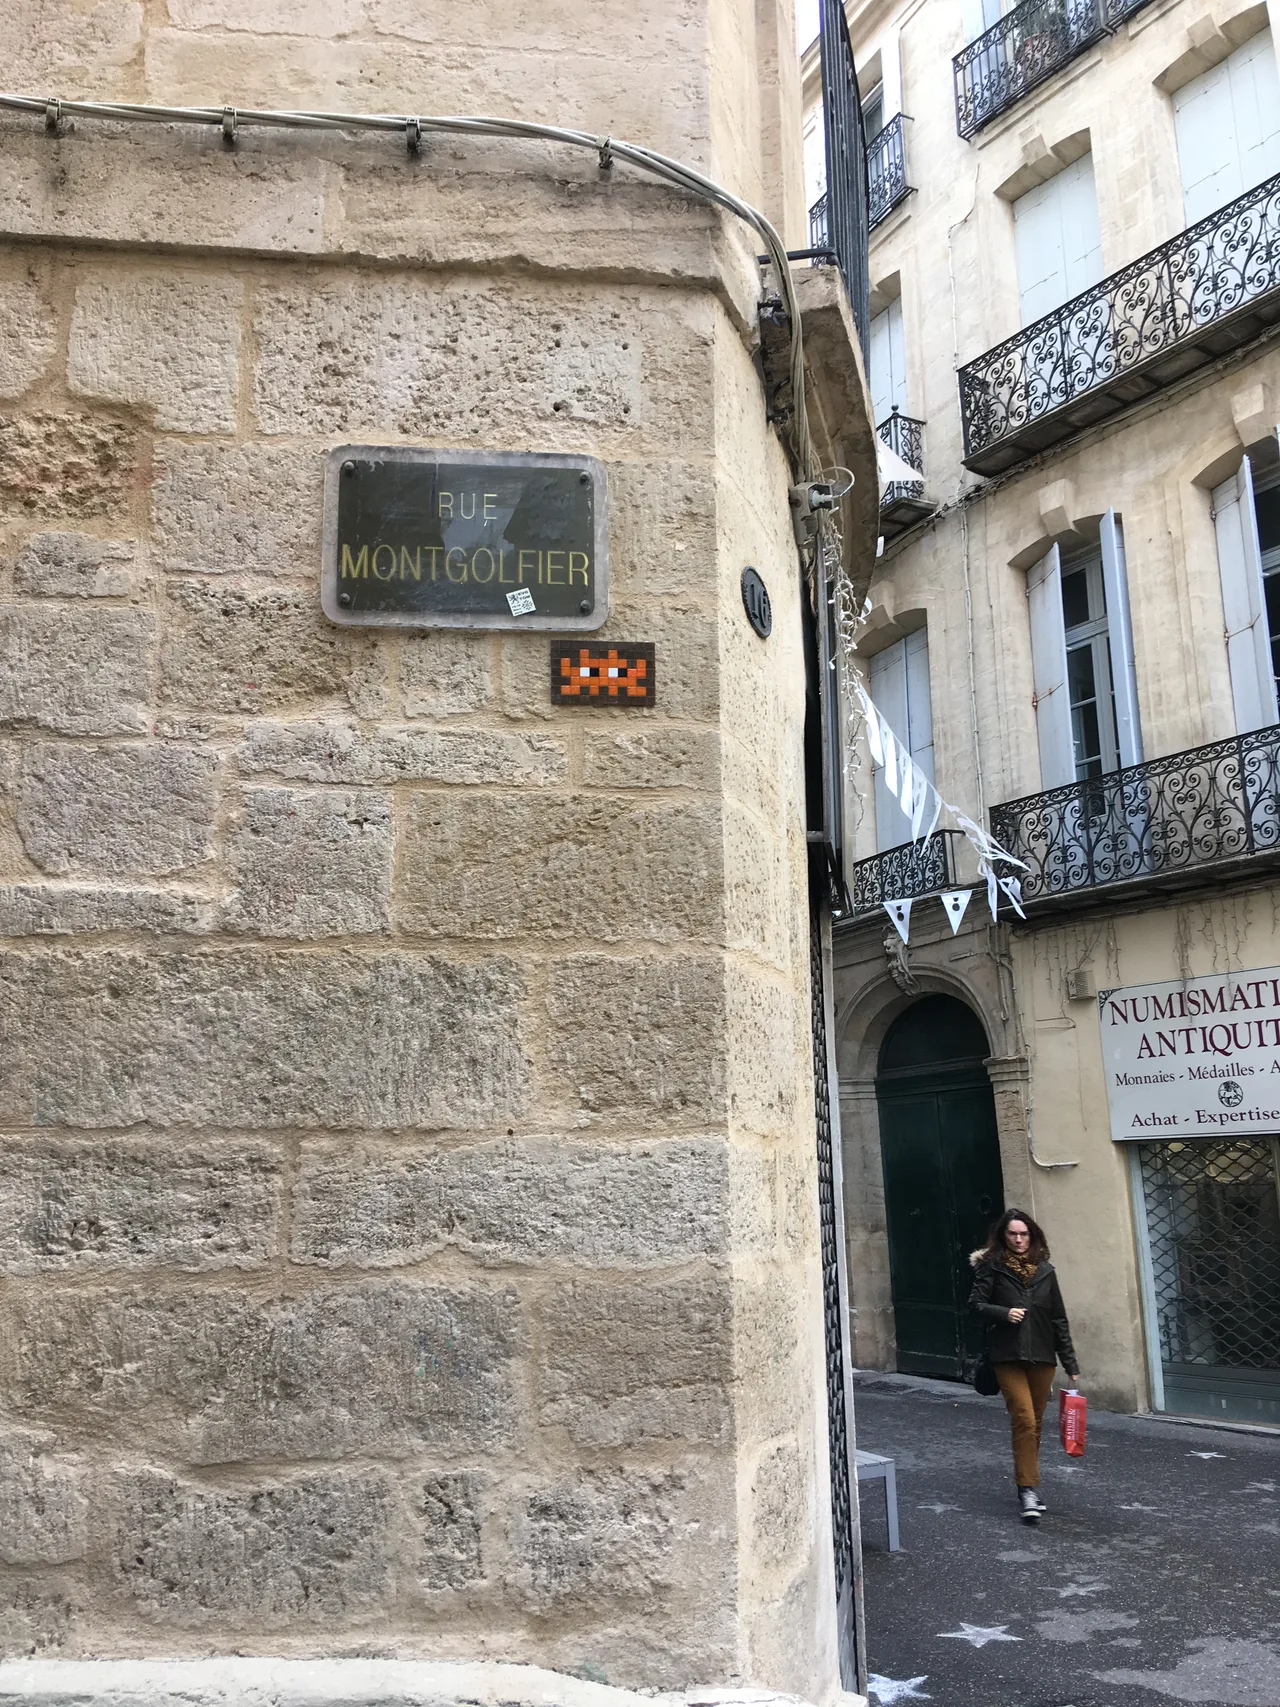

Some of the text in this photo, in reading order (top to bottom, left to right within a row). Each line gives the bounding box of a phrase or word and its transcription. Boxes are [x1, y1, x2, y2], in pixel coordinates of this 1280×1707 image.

[438, 492, 498, 520] RUE
[340, 544, 589, 586] MONTGOLFIER
[1108, 978, 1280, 1026] NUMISMATI
[1136, 1018, 1280, 1060] ANTIQUIT
[1115, 1070, 1175, 1087] Monnaies
[1187, 1062, 1255, 1081] Médailles
[1131, 1112, 1178, 1128] Achat
[1195, 1106, 1280, 1126] Expertise
